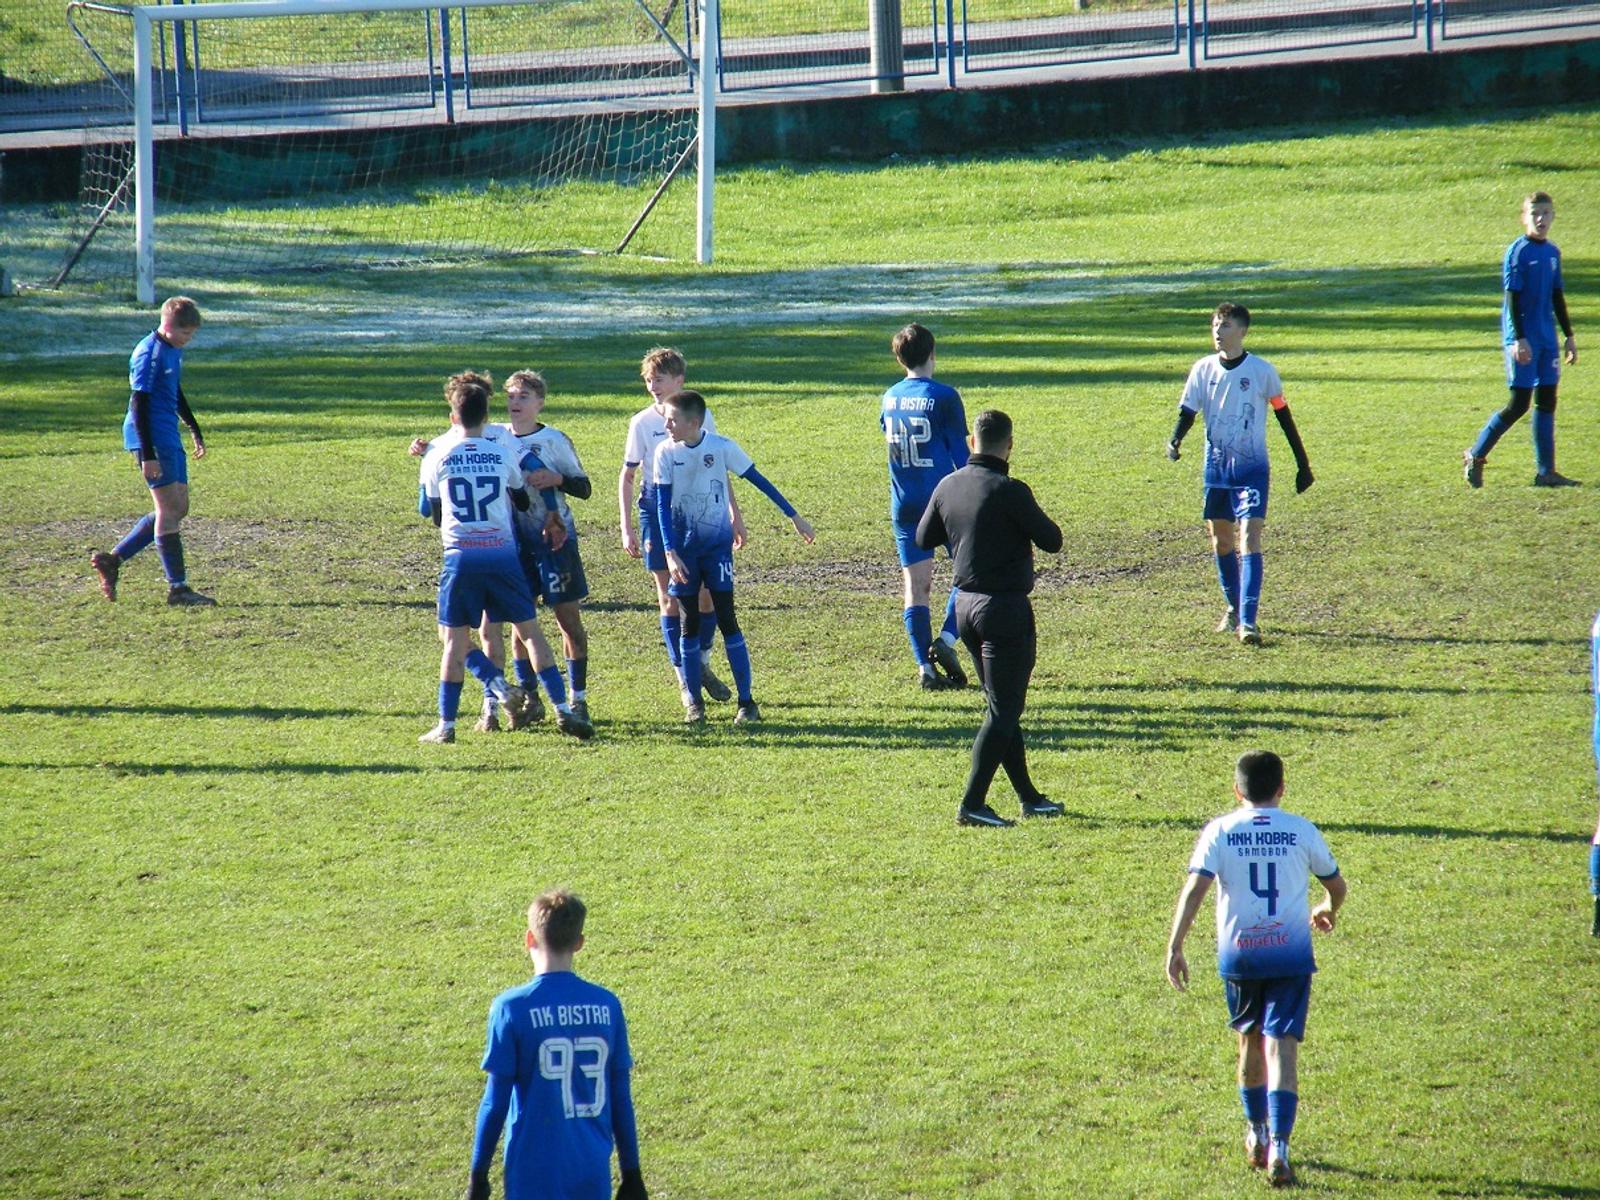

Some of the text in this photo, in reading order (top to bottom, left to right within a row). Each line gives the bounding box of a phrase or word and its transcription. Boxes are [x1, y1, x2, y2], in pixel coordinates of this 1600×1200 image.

[900, 396, 936, 411] BISTRA
[448, 476, 500, 523] 97
[548, 572, 571, 593] 27
[718, 562, 733, 582] 14
[1227, 832, 1253, 847] HNK
[1249, 862, 1280, 917] 4
[529, 1004, 612, 1029] NK BISTRA
[538, 1036, 610, 1120] 93
